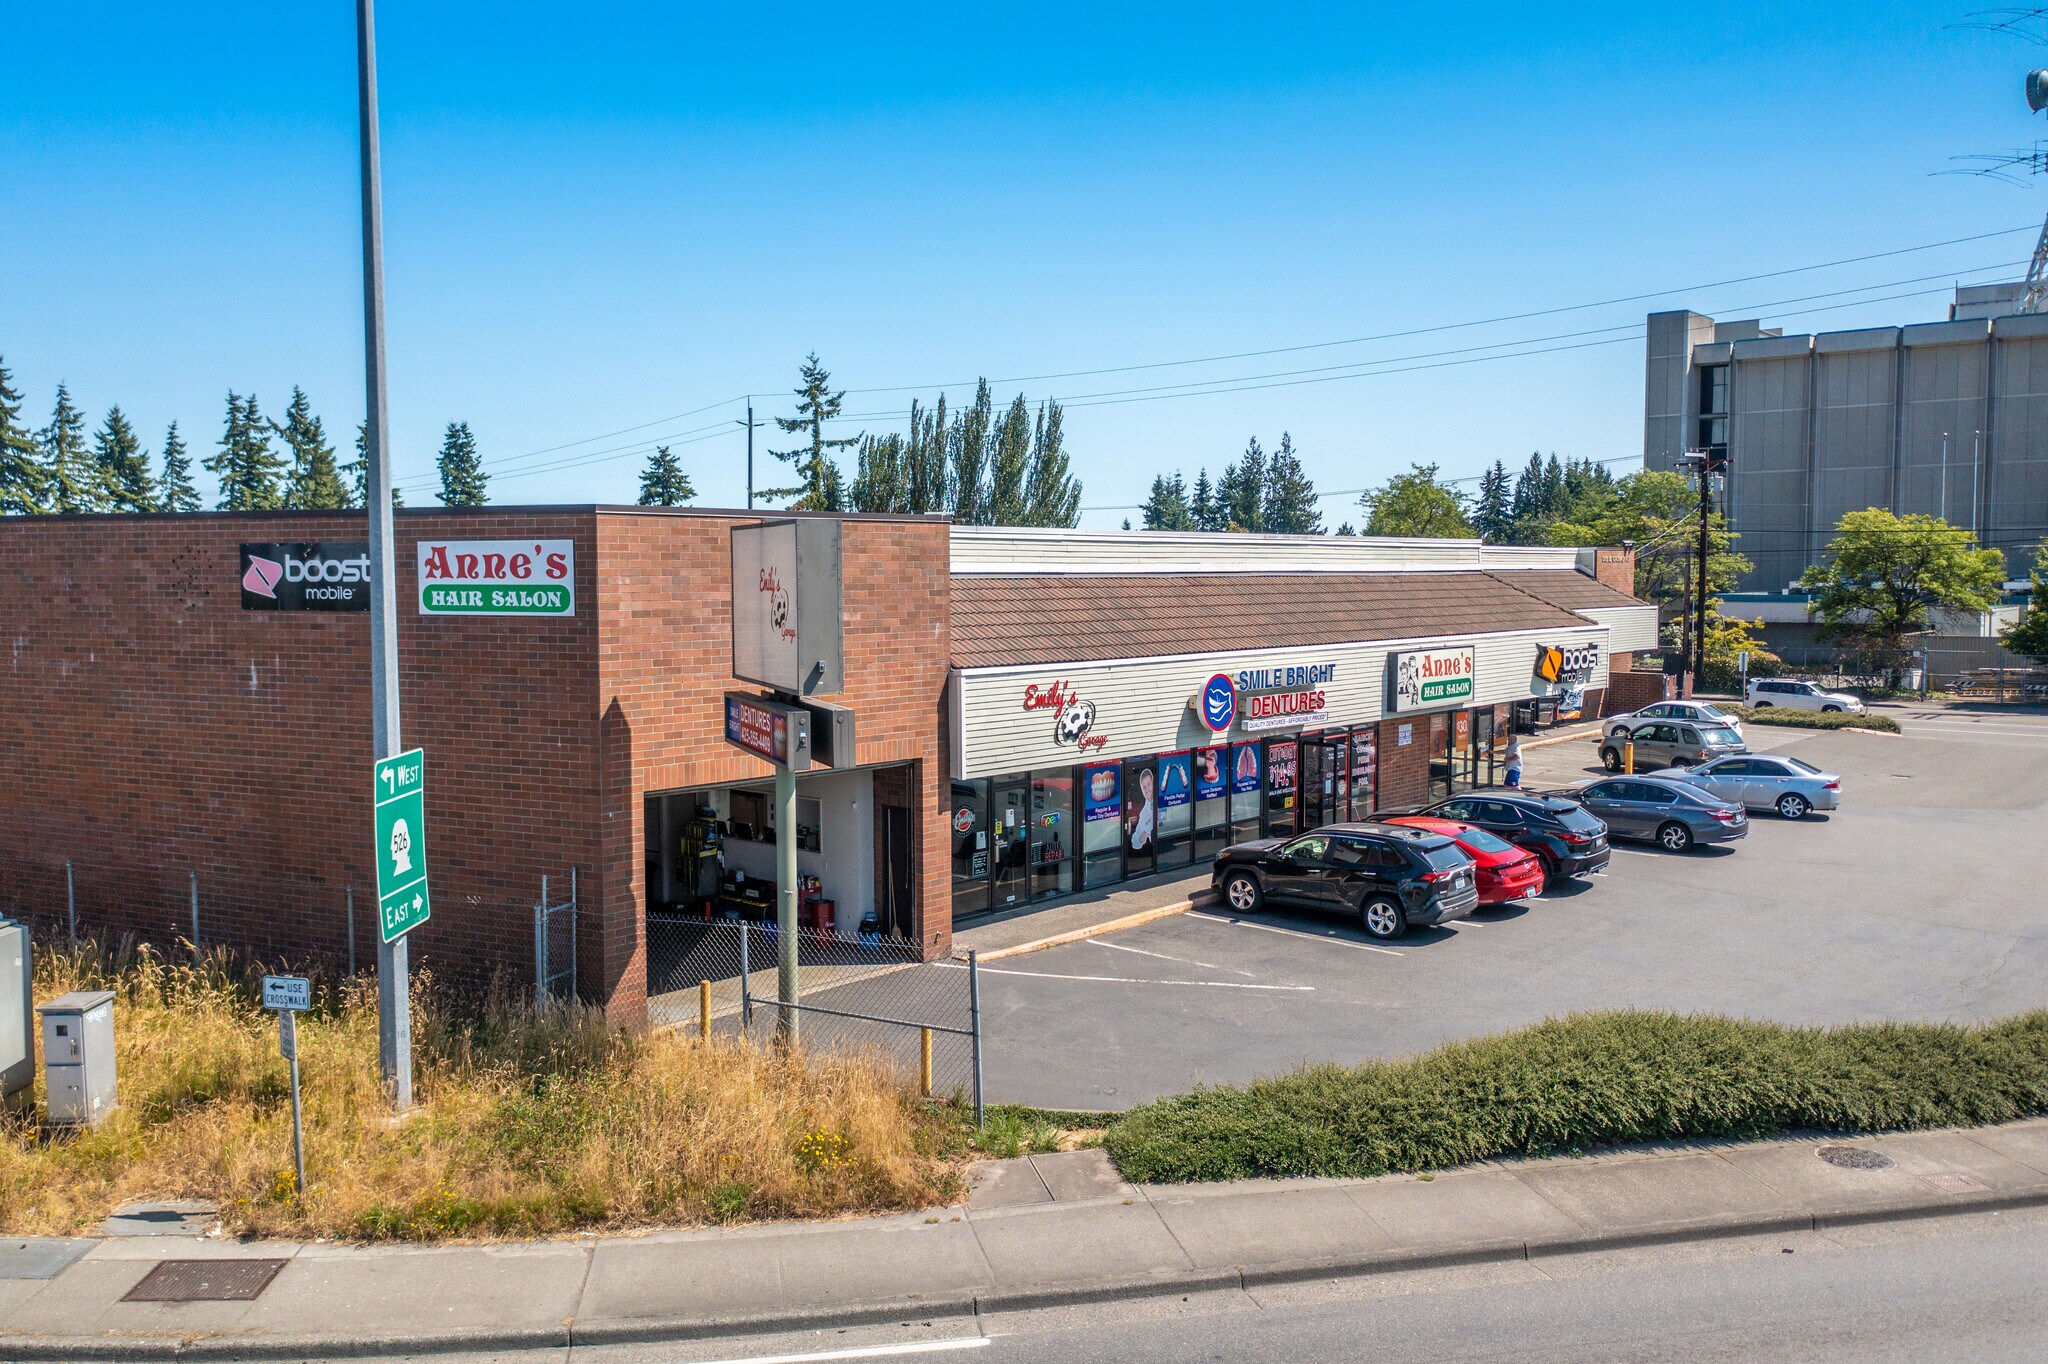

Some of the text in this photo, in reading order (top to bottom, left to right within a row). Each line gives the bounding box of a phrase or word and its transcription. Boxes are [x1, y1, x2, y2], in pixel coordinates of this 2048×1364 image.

[285, 553, 371, 583] boost
[424, 544, 568, 580] Anne's
[306, 586, 353, 600] mobile
[760, 566, 781, 604] Emily's
[431, 590, 562, 608] HAIR SALON
[1422, 651, 1472, 678] Anne's
[1563, 644, 1600, 671] boost
[1239, 663, 1336, 692] SMILE BRIGHT
[1423, 682, 1470, 698] HAIR SALON
[1024, 680, 1079, 720] Emily's
[1251, 690, 1326, 718] DENTURES
[740, 704, 771, 732] DENTURES
[1248, 721, 1266, 729] QUALITY
[1266, 718, 1286, 727] DENTURES
[1079, 732, 1109, 753] Garage
[397, 764, 420, 788] WEST
[393, 830, 409, 854] 526
[385, 902, 409, 930] EAST
[266, 993, 307, 1006] CROSSWALK
[287, 983, 303, 994] USE
